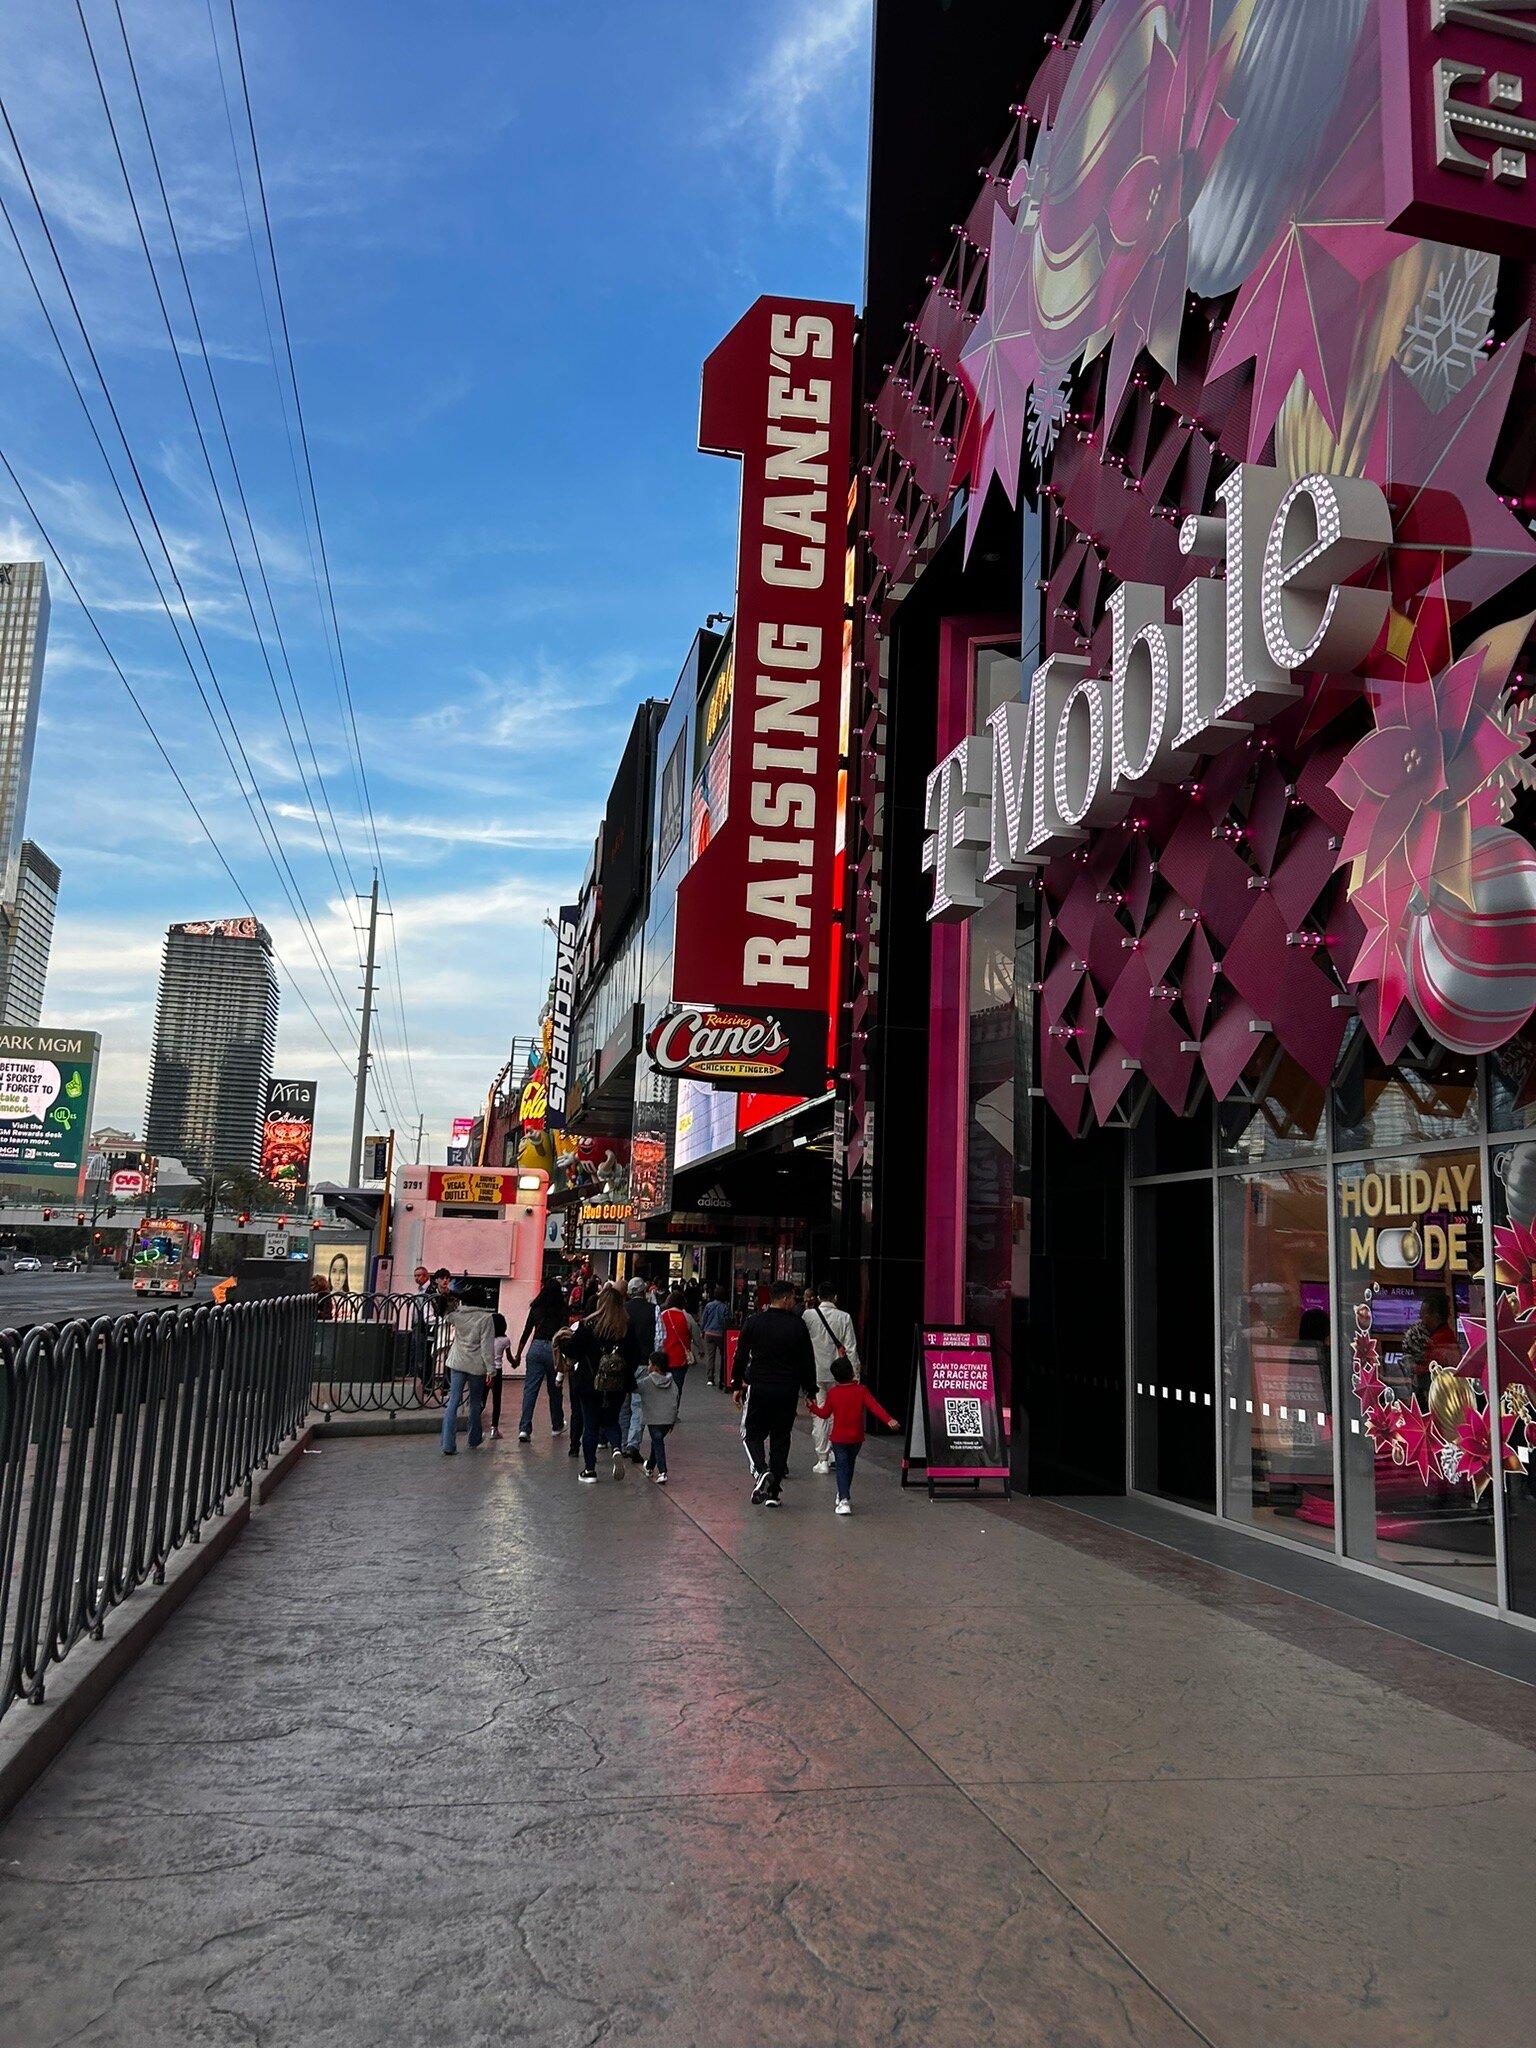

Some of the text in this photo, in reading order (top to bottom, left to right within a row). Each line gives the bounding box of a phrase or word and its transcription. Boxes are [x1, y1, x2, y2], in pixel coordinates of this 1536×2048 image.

[743, 313, 834, 989] RAISING CANE'S
[549, 919, 576, 1114] SKECHERS
[705, 1014, 752, 1028] Raising
[656, 1009, 789, 1069] Cane's
[0, 1035, 82, 1054] ARK MGM
[0, 1063, 35, 1074] BETTING
[700, 1063, 775, 1074] CHICKEN FINGERS
[6, 1073, 43, 1083] SPORTS?
[6, 1084, 38, 1094] FORGET
[42, 1085, 53, 1094] TO
[271, 1083, 310, 1102] Aria
[1, 1093, 20, 1102] take
[0, 1101, 32, 1113] imeout.
[115, 1175, 141, 1185] CVS
[403, 1181, 423, 1190] 3791
[446, 1182, 466, 1190] VEGAS
[445, 1190, 468, 1200] OUTLET
[1340, 1165, 1476, 1217] HOLIDAY
[698, 1199, 731, 1208] adidas
[603, 1204, 632, 1219] COUR
[267, 1246, 285, 1256] 30
[1385, 1352, 1403, 1364] UF
[932, 1362, 950, 1370] SCAN
[933, 1370, 988, 1380] AR RACE CAR
[932, 1380, 988, 1390] EXPERIENCE
